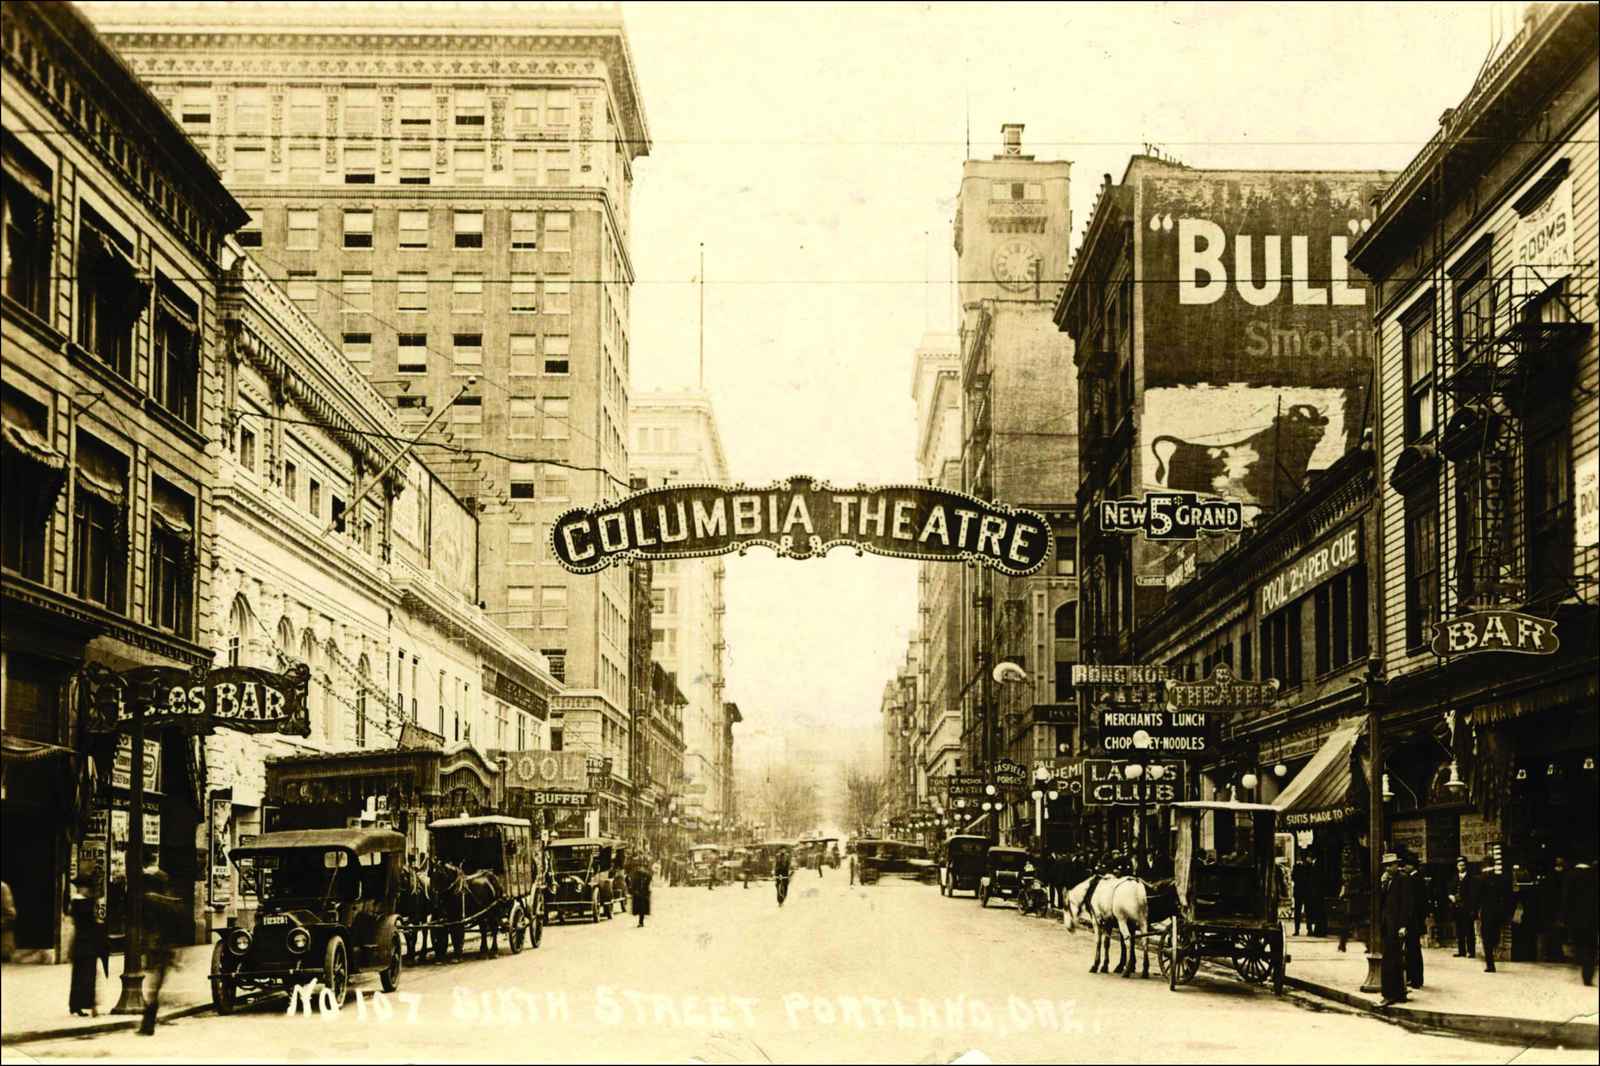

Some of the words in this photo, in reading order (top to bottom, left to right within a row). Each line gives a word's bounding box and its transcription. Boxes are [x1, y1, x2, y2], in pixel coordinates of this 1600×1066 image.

[1103, 503, 1148, 527] NEW
[1175, 505, 1239, 526] GRAND
[562, 494, 813, 563] COLUMBIA
[832, 495, 1040, 564] THEATRE
[1261, 573, 1288, 615] POOL
[1307, 551, 1329, 581] PER
[1330, 529, 1358, 567] CUE
[1448, 616, 1549, 653] BAR
[1132, 666, 1177, 684] KON
[212, 682, 288, 720] BAR
[1104, 712, 1164, 727] MERCHANTS
[1172, 712, 1205, 727] LUNCH
[1104, 736, 1133, 750] CHOP
[496, 756, 580, 782] POOL
[534, 791, 588, 805] BUFFET
[1093, 784, 1175, 801] CLUB
[1310, 811, 1331, 823] MADE
[1332, 809, 1343, 819] TO
